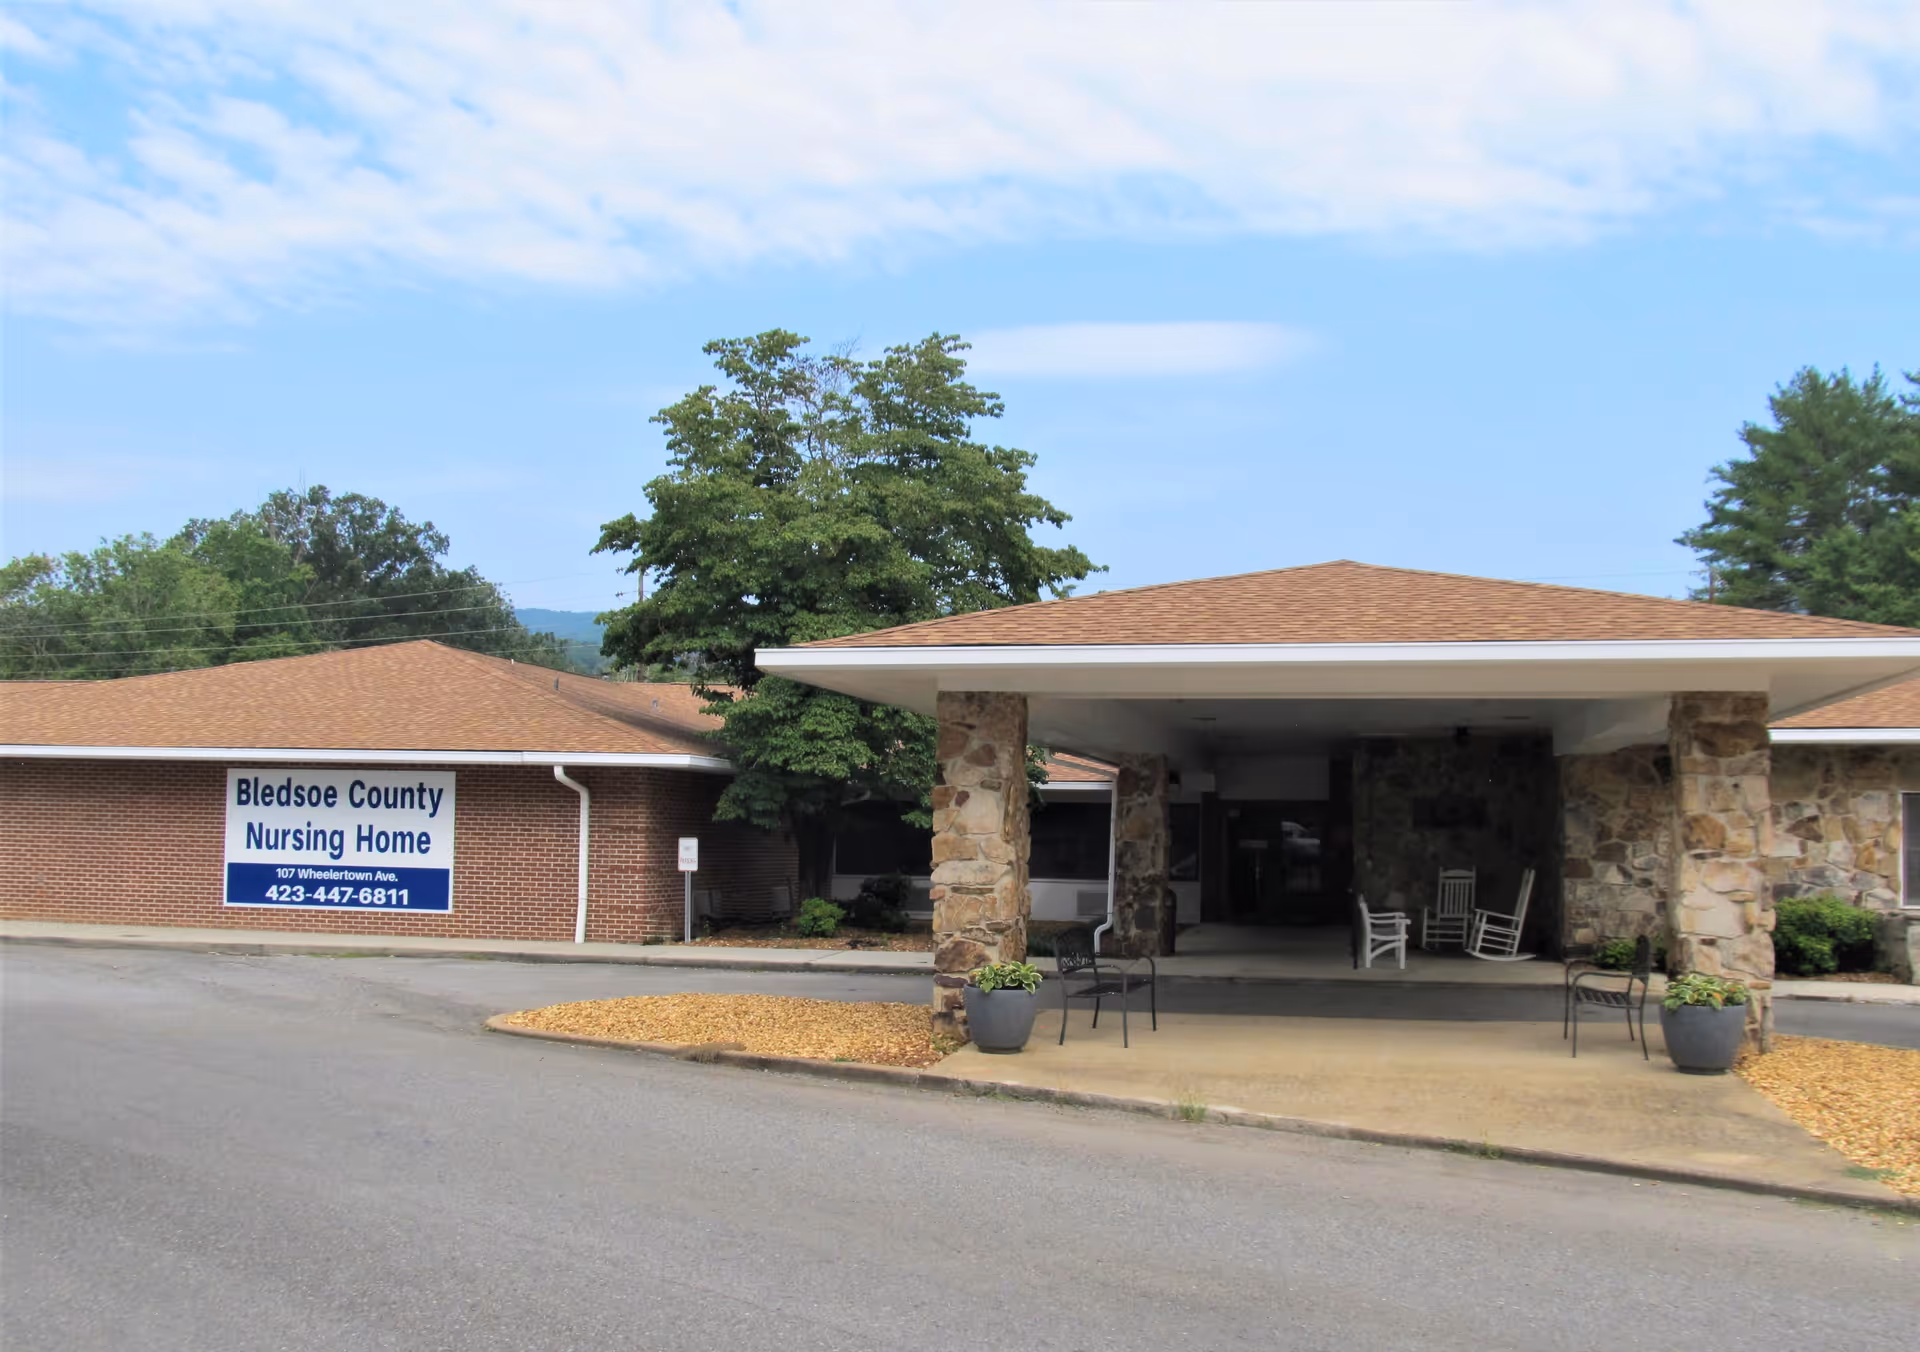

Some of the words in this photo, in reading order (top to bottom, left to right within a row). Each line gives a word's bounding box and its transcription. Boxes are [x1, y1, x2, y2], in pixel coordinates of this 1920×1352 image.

[237, 777, 338, 808] Bledsoe
[349, 780, 443, 818] County
[246, 821, 345, 860] Nursing
[356, 824, 431, 854] Home
[276, 868, 295, 879] 107
[297, 868, 373, 881] Wheelertown
[375, 870, 399, 882] Ave.
[265, 885, 408, 905] 423-447-6811
